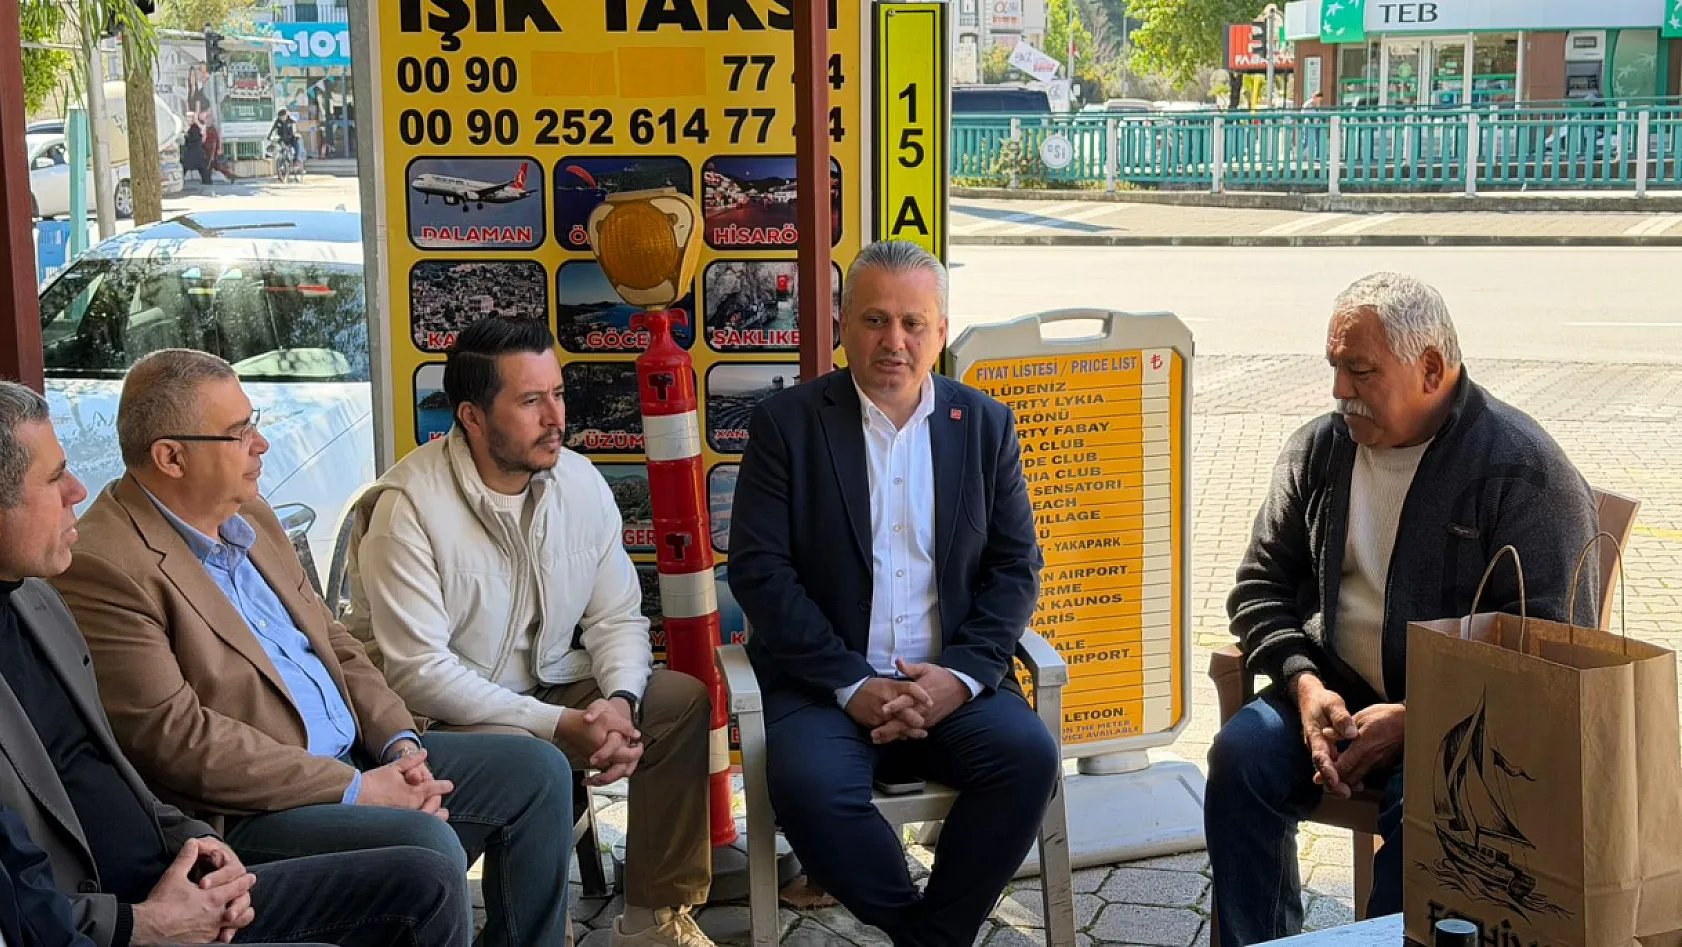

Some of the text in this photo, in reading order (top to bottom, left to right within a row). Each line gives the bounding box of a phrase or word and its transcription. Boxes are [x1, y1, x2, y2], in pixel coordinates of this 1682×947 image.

[1378, 3, 1438, 23] TEB
[398, 53, 845, 93] 00 90 77 4
[399, 106, 845, 145] 00 90 252 614 77 4
[422, 226, 533, 243] DALAMAN
[713, 223, 798, 244] HİSARÖ
[587, 328, 650, 348] GÖCE
[712, 330, 800, 345] SAKLIKE
[976, 363, 1009, 381] FİYAT
[1013, 357, 1058, 378] LİSTESİ
[1071, 358, 1108, 374] PRICE
[1111, 356, 1137, 370] LIST
[1055, 394, 1104, 407] LYKIA
[1014, 408, 1069, 424] RÖNÜ
[714, 429, 750, 440] XAN
[1054, 422, 1110, 437] FABAY
[585, 430, 646, 448] ÜZÜM
[1040, 439, 1084, 451] CLUB
[1052, 453, 1097, 465] CLUB
[1055, 467, 1101, 479] CLUB
[1034, 480, 1122, 496] SENSATORI
[1055, 537, 1121, 552] YAKAPARK
[1059, 566, 1128, 580] AIRPORT
[1051, 594, 1123, 610] KAUNOS
